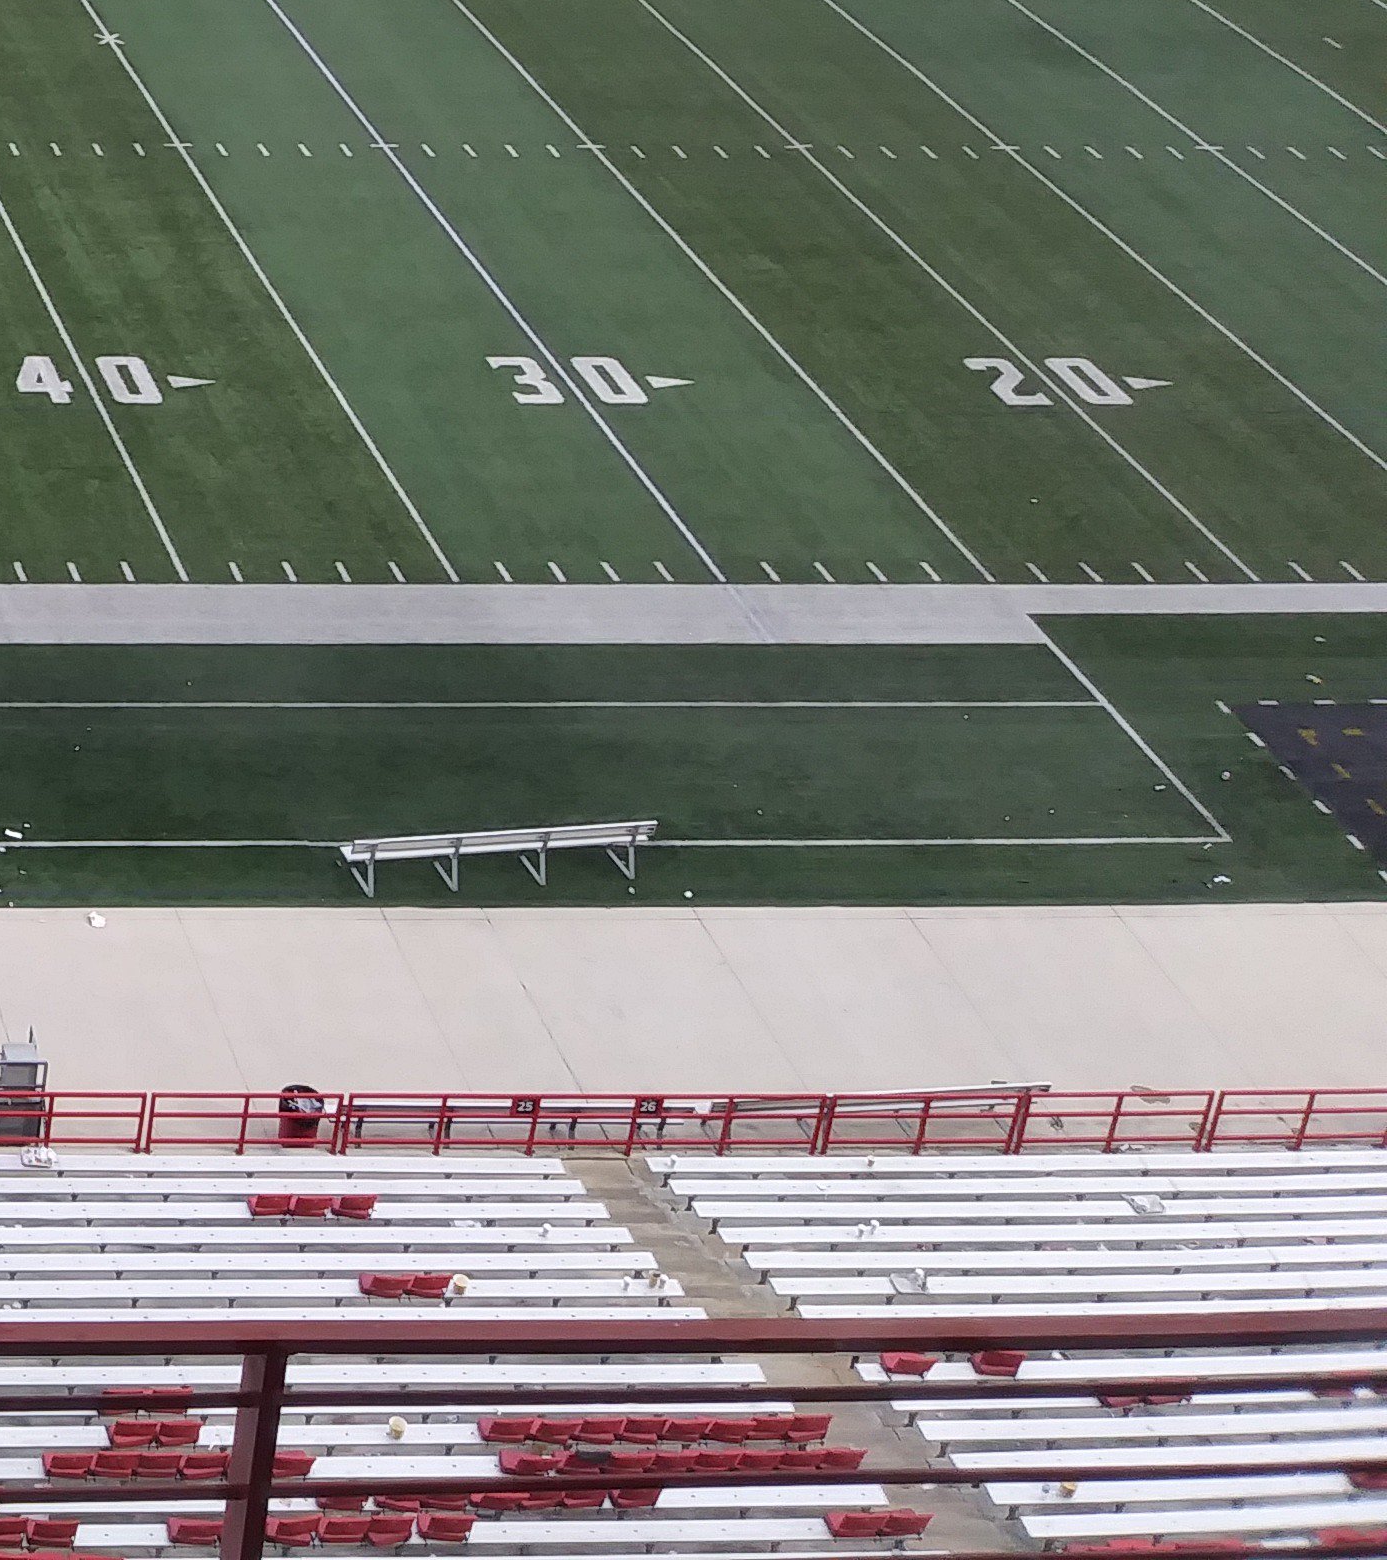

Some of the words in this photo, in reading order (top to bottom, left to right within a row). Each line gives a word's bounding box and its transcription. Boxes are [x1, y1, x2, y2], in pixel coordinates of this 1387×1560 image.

[15, 355, 164, 405] 40
[485, 356, 649, 405] 30
[962, 357, 1135, 406] 20
[517, 1101, 534, 1112] 25
[640, 1101, 657, 1112] 26
